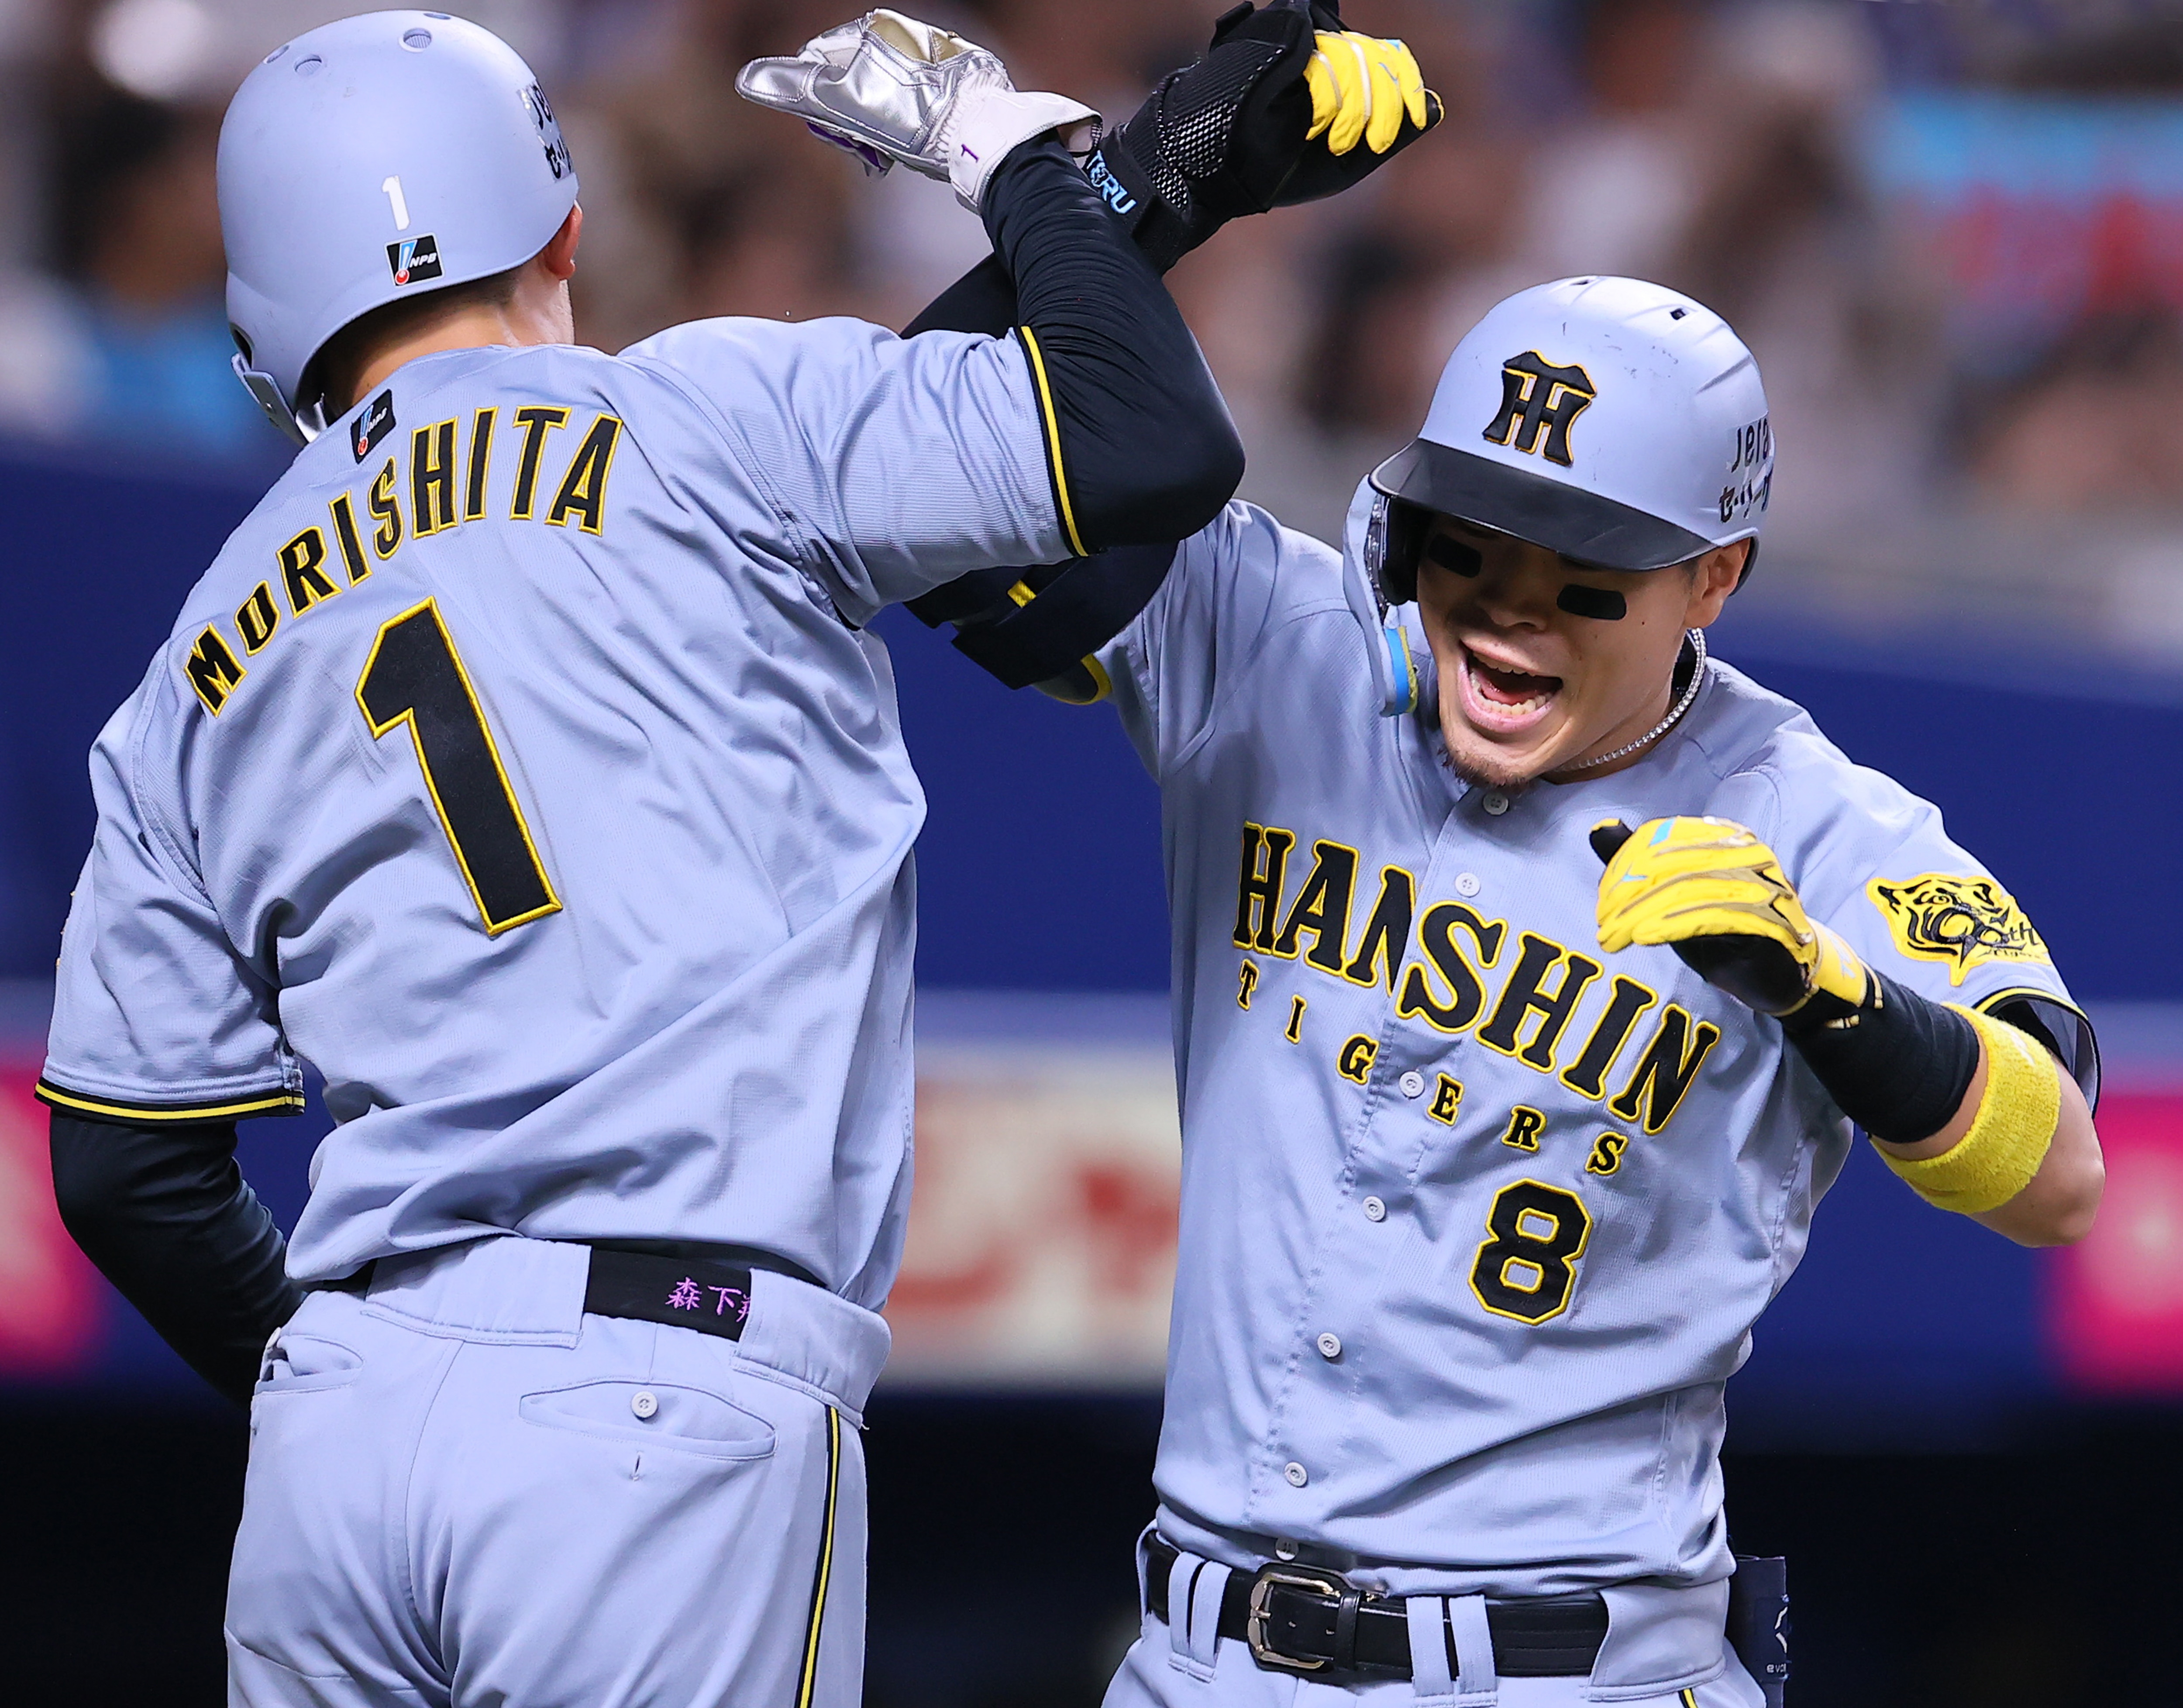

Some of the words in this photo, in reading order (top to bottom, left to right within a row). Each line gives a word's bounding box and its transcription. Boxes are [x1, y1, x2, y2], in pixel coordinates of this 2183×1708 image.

[382, 176, 410, 230] 1
[961, 144, 978, 163] 1
[409, 252, 437, 268] NPB
[183, 405, 623, 716] MORISHITA
[354, 595, 563, 936] 1
[1233, 820, 1720, 1135] HANSHIN
[1237, 959, 1629, 1175] TIGERS
[1467, 1178, 1593, 1326] 8
